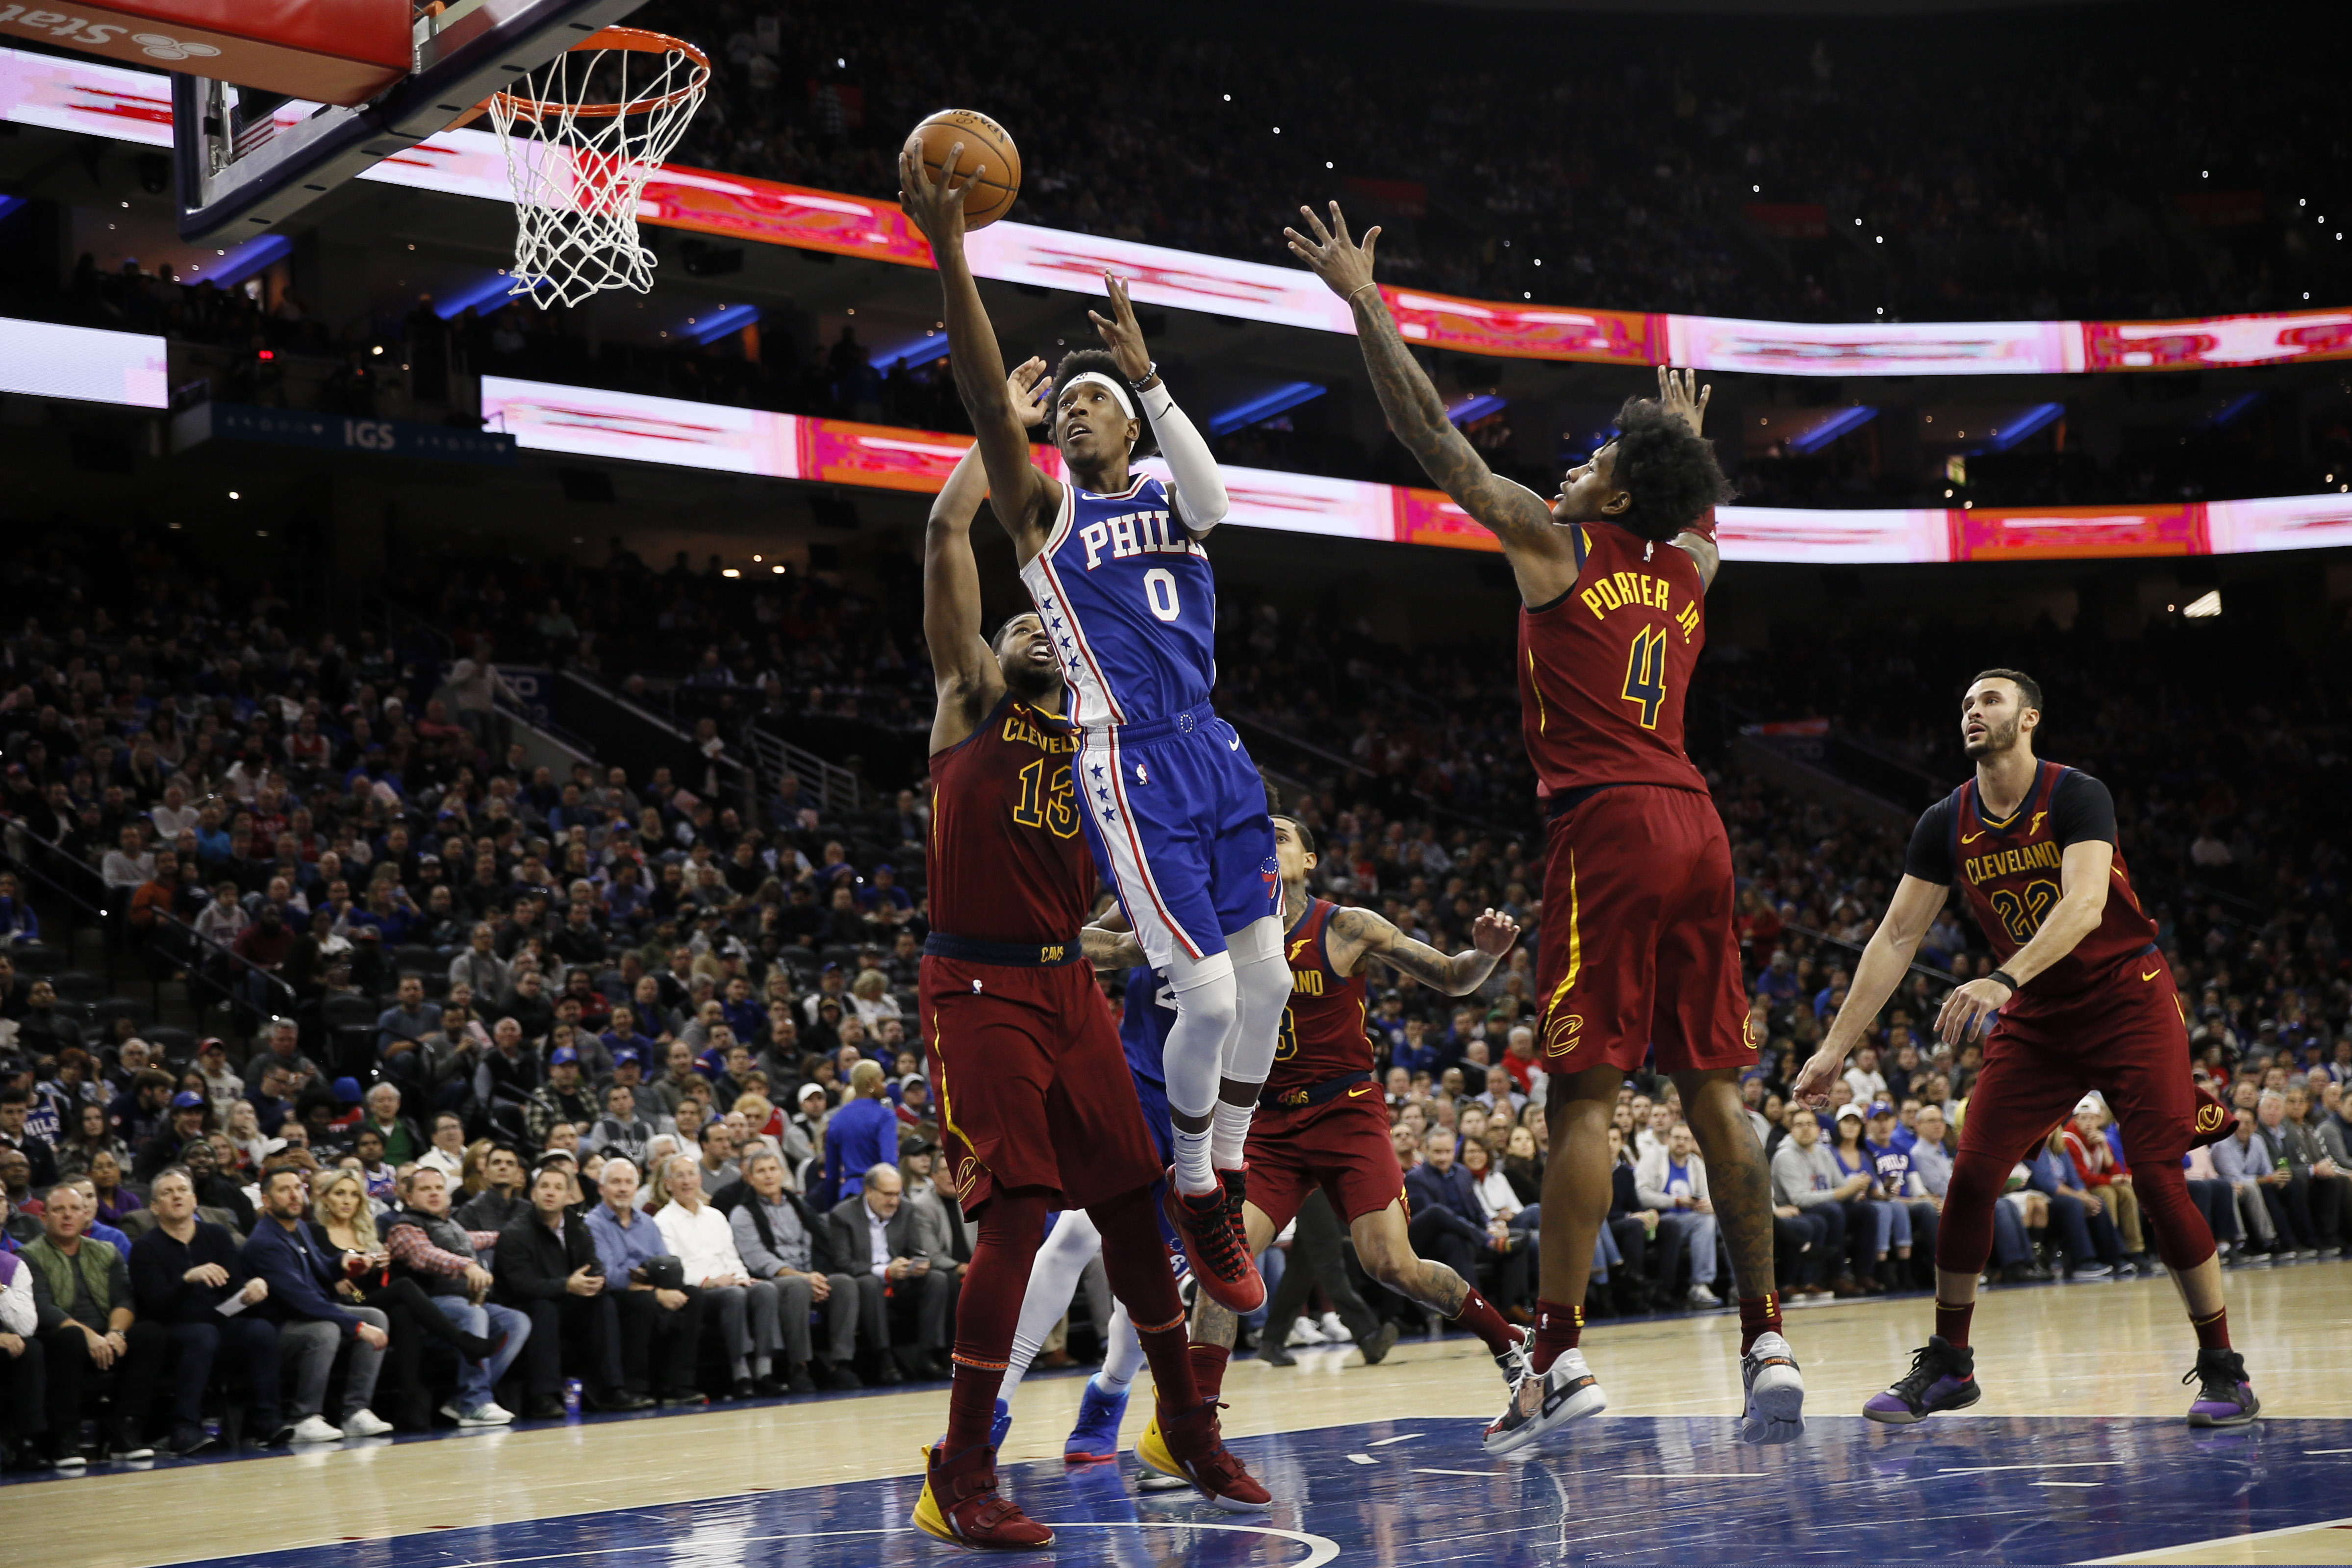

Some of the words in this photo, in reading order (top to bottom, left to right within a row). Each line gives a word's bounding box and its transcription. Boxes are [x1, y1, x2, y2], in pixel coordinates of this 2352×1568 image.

[0, 4, 128, 44] Stat
[343, 419, 395, 450] IGS
[1143, 568, 1181, 622] 0
[1580, 572, 1670, 621] PORTER
[1675, 600, 1700, 645] JR.
[1621, 623, 1667, 731] 4
[1002, 716, 1081, 754] CLEVELA
[1013, 758, 1081, 839] 13
[1965, 840, 2062, 886] CLEVELAND
[1990, 879, 2062, 945] 22
[1040, 945, 1064, 963] CAVS
